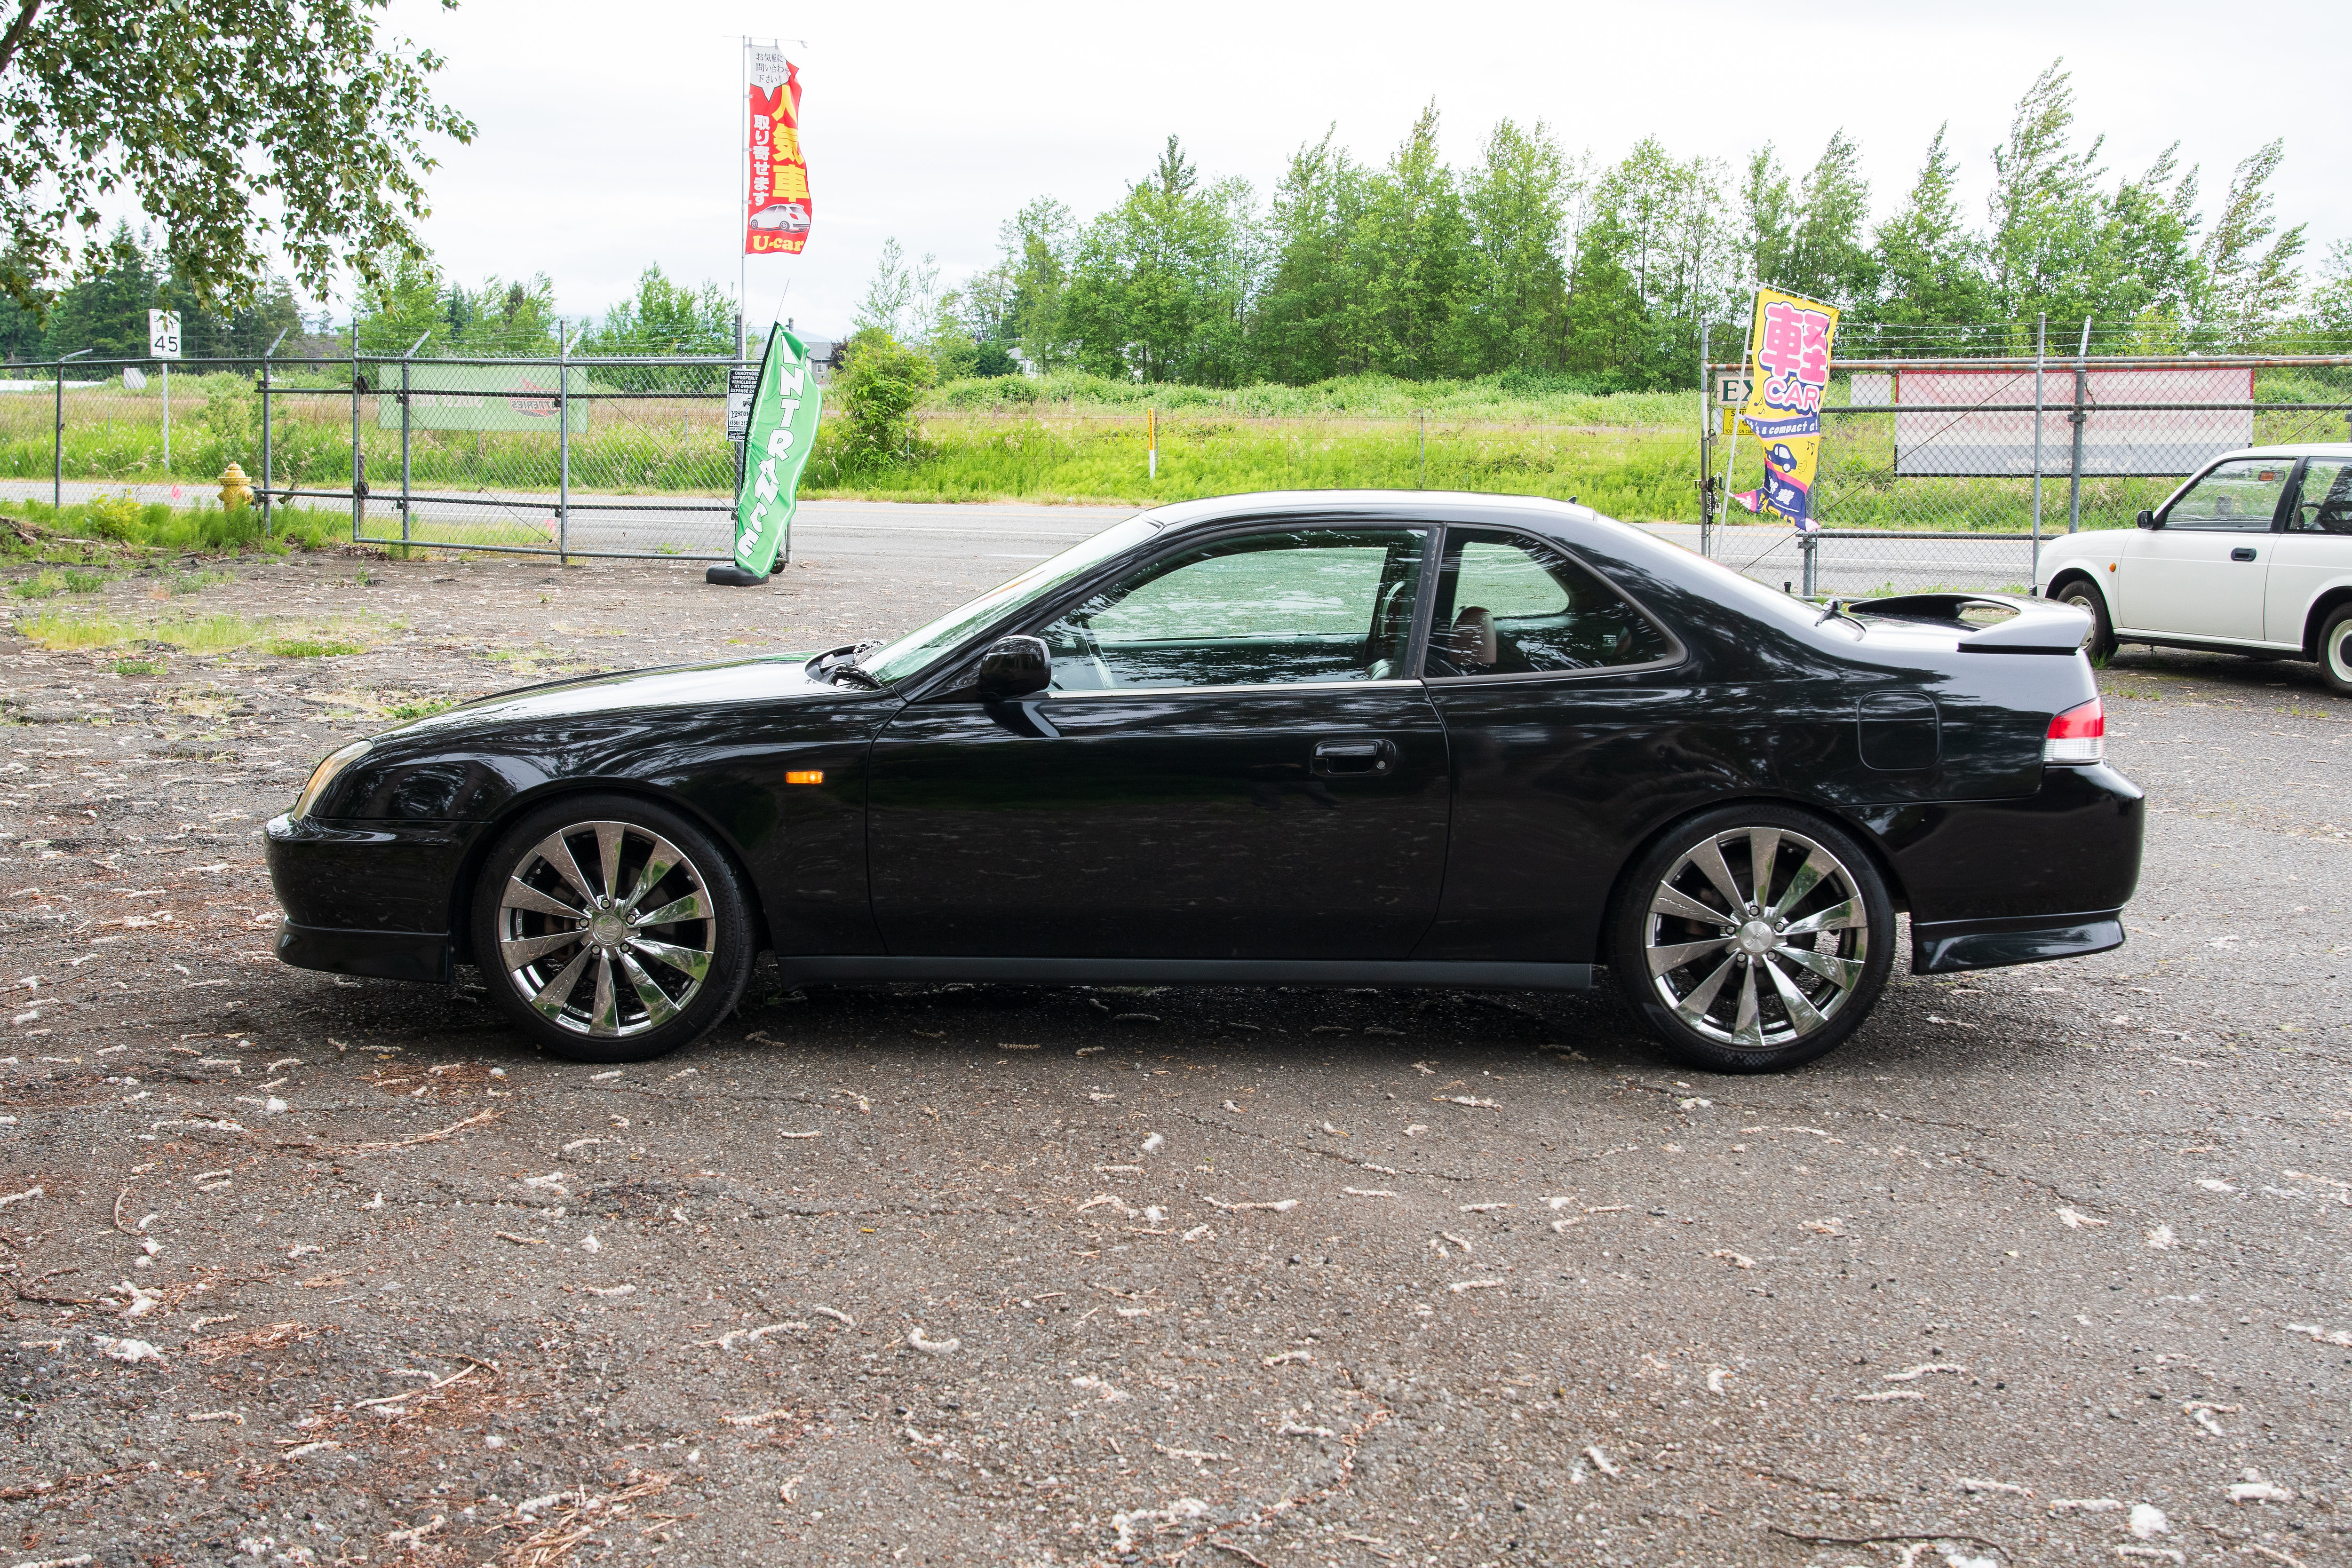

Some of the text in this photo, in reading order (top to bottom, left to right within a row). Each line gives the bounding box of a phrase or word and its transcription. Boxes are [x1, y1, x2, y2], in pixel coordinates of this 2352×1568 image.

[756, 52, 784, 63] お気軽に
[756, 63, 789, 76] 問い合わせ
[772, 85, 810, 203] 人気車
[753, 114, 770, 206] 取り寄せます
[753, 235, 804, 251] U-car
[154, 335, 178, 352] 45
[1760, 303, 1828, 385] 軽
[1765, 379, 1820, 411] CAR
[1769, 420, 1808, 435] compact
